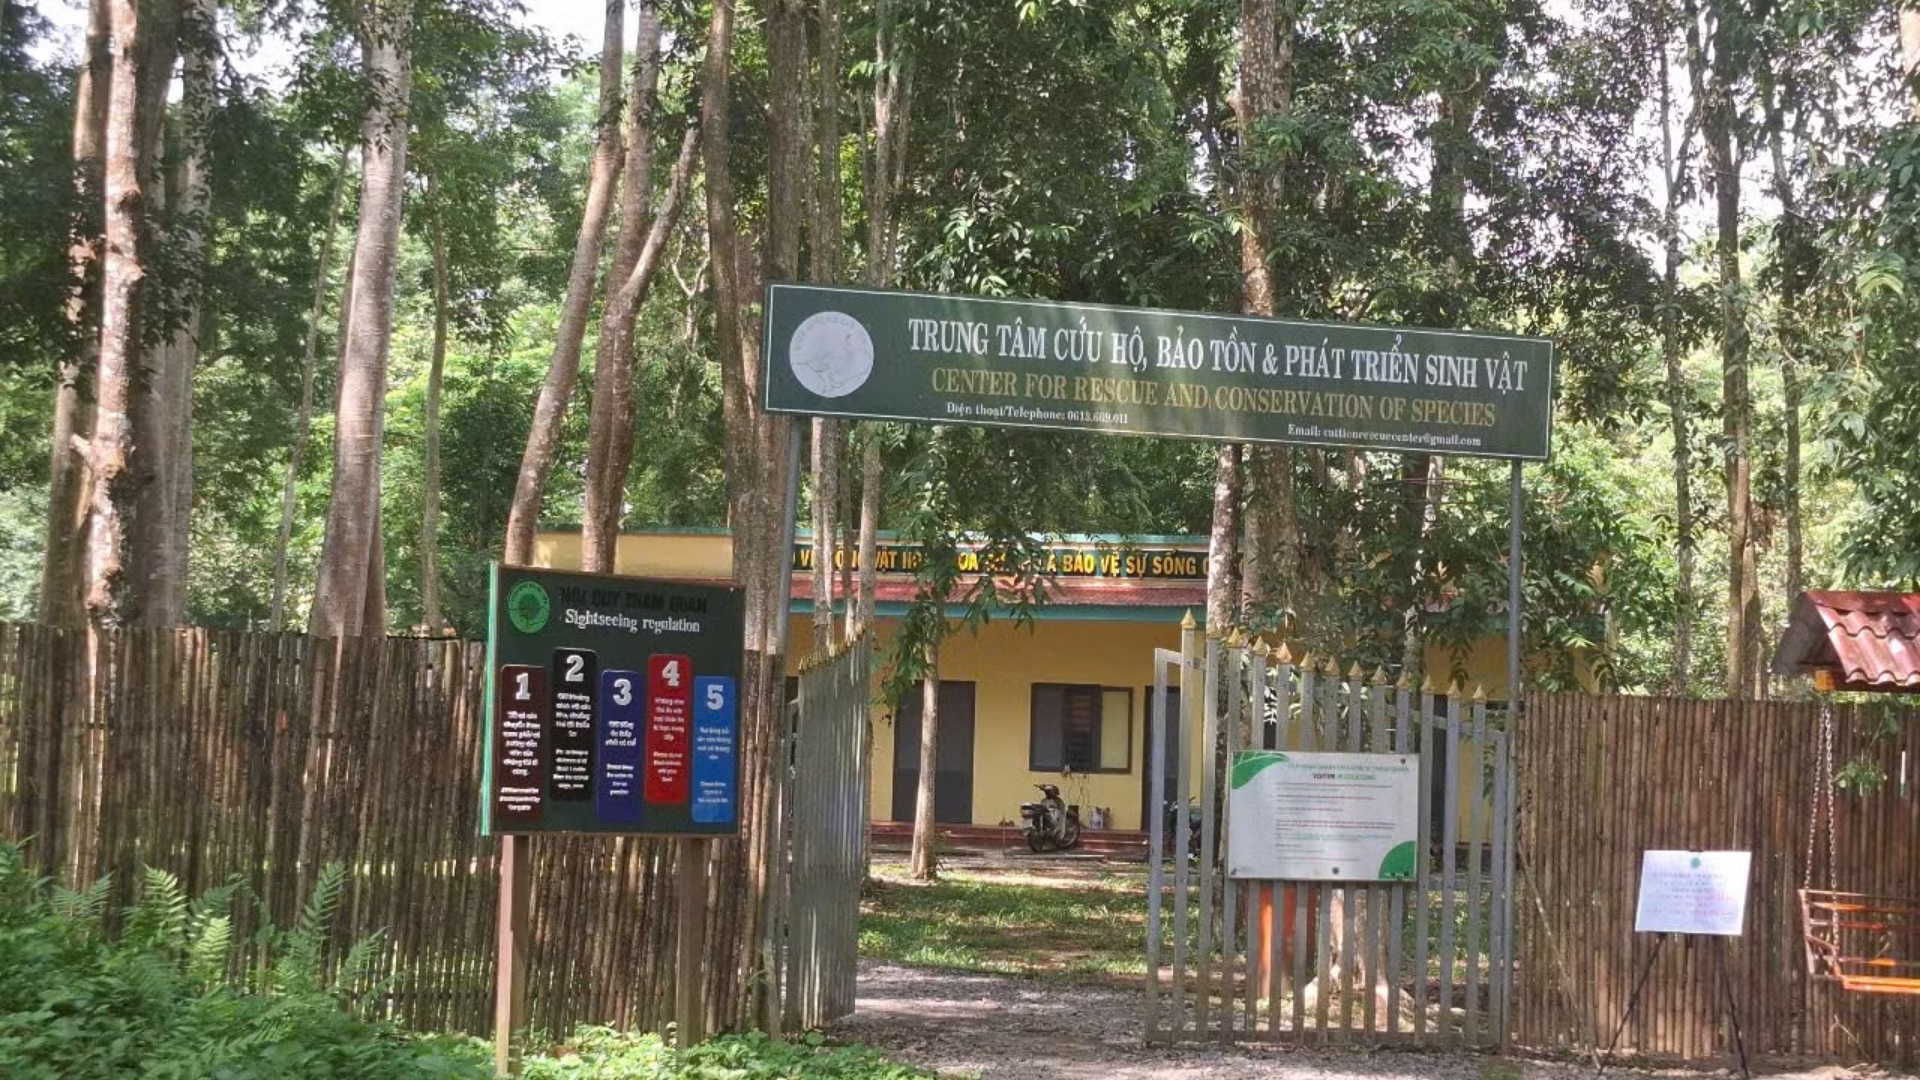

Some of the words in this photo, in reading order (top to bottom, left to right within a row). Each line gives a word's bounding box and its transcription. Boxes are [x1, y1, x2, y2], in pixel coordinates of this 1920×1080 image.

[909, 318, 989, 355] TRUNG
[996, 316, 1047, 359] TÂM
[1054, 316, 1103, 362] CỨU
[1111, 325, 1148, 373] HỘ,
[1156, 325, 1204, 370] BẢO
[1210, 326, 1257, 373] TỒN
[1263, 343, 1279, 375] &
[1285, 337, 1346, 379] PHÁT
[1351, 334, 1420, 384] TRIỂN
[1425, 354, 1478, 388] SINH
[1485, 351, 1528, 396] VẬT
[932, 367, 1018, 397] CENTER
[1024, 372, 1068, 401] FOR
[1075, 375, 1159, 405] RESCUE
[1164, 383, 1209, 409] AND
[1215, 386, 1374, 419] CONSERVATION
[1379, 397, 1406, 422] OF
[1411, 398, 1496, 427] SPECIES
[947, 402, 973, 417] Điện
[1288, 424, 1321, 437] Email:
[1063, 549, 1096, 573] BẢO
[1101, 552, 1120, 576] VỆ
[1126, 553, 1148, 579] SỰ
[1153, 551, 1197, 576] SỐNG
[565, 608, 639, 633] Sightseeing
[642, 616, 701, 635] regulation
[565, 655, 584, 682] 2
[662, 660, 680, 687] 4
[515, 673, 531, 700] 1
[613, 679, 632, 706] 3
[707, 684, 724, 710] 5
